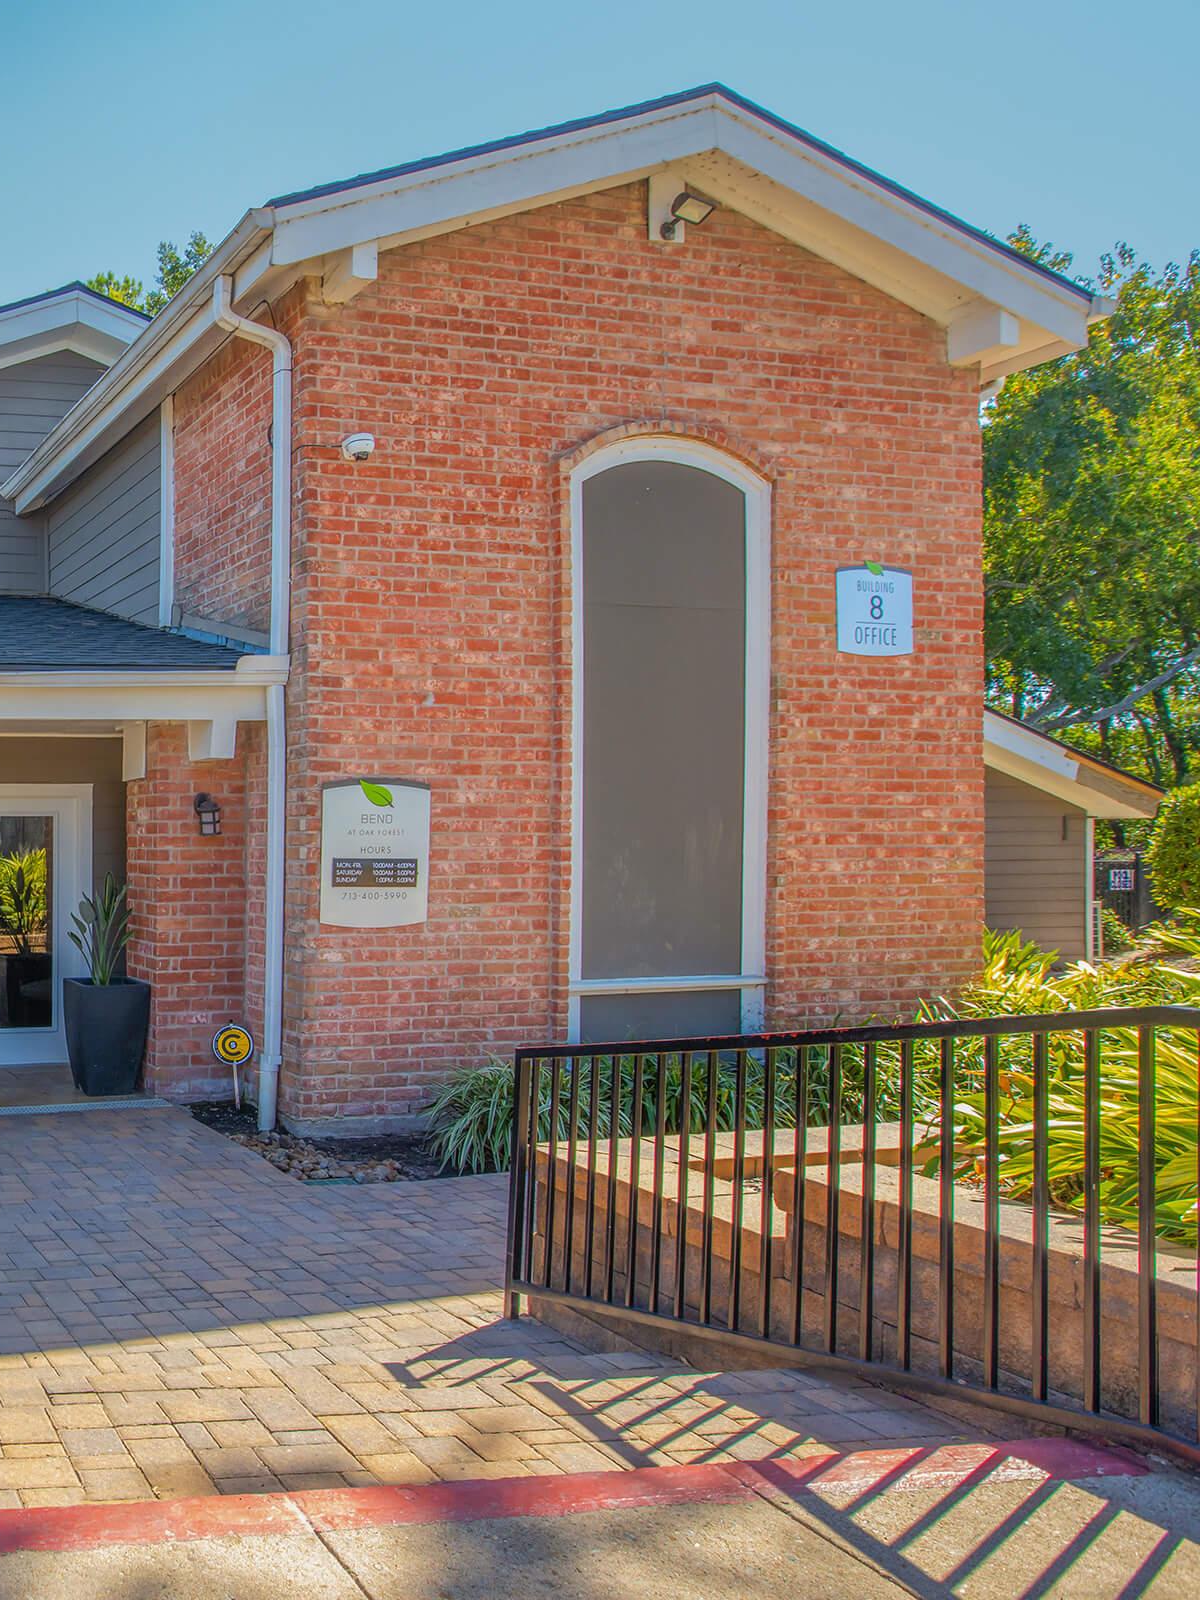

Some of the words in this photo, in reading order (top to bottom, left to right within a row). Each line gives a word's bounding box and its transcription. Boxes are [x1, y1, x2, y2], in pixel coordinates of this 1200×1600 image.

[857, 580, 894, 593] BUILDING
[870, 595, 883, 620] 8
[855, 626, 897, 646] OFFICE
[360, 814, 393, 824] BEND
[360, 846, 392, 854] HOURS
[341, 891, 408, 900] 713-400-5990
